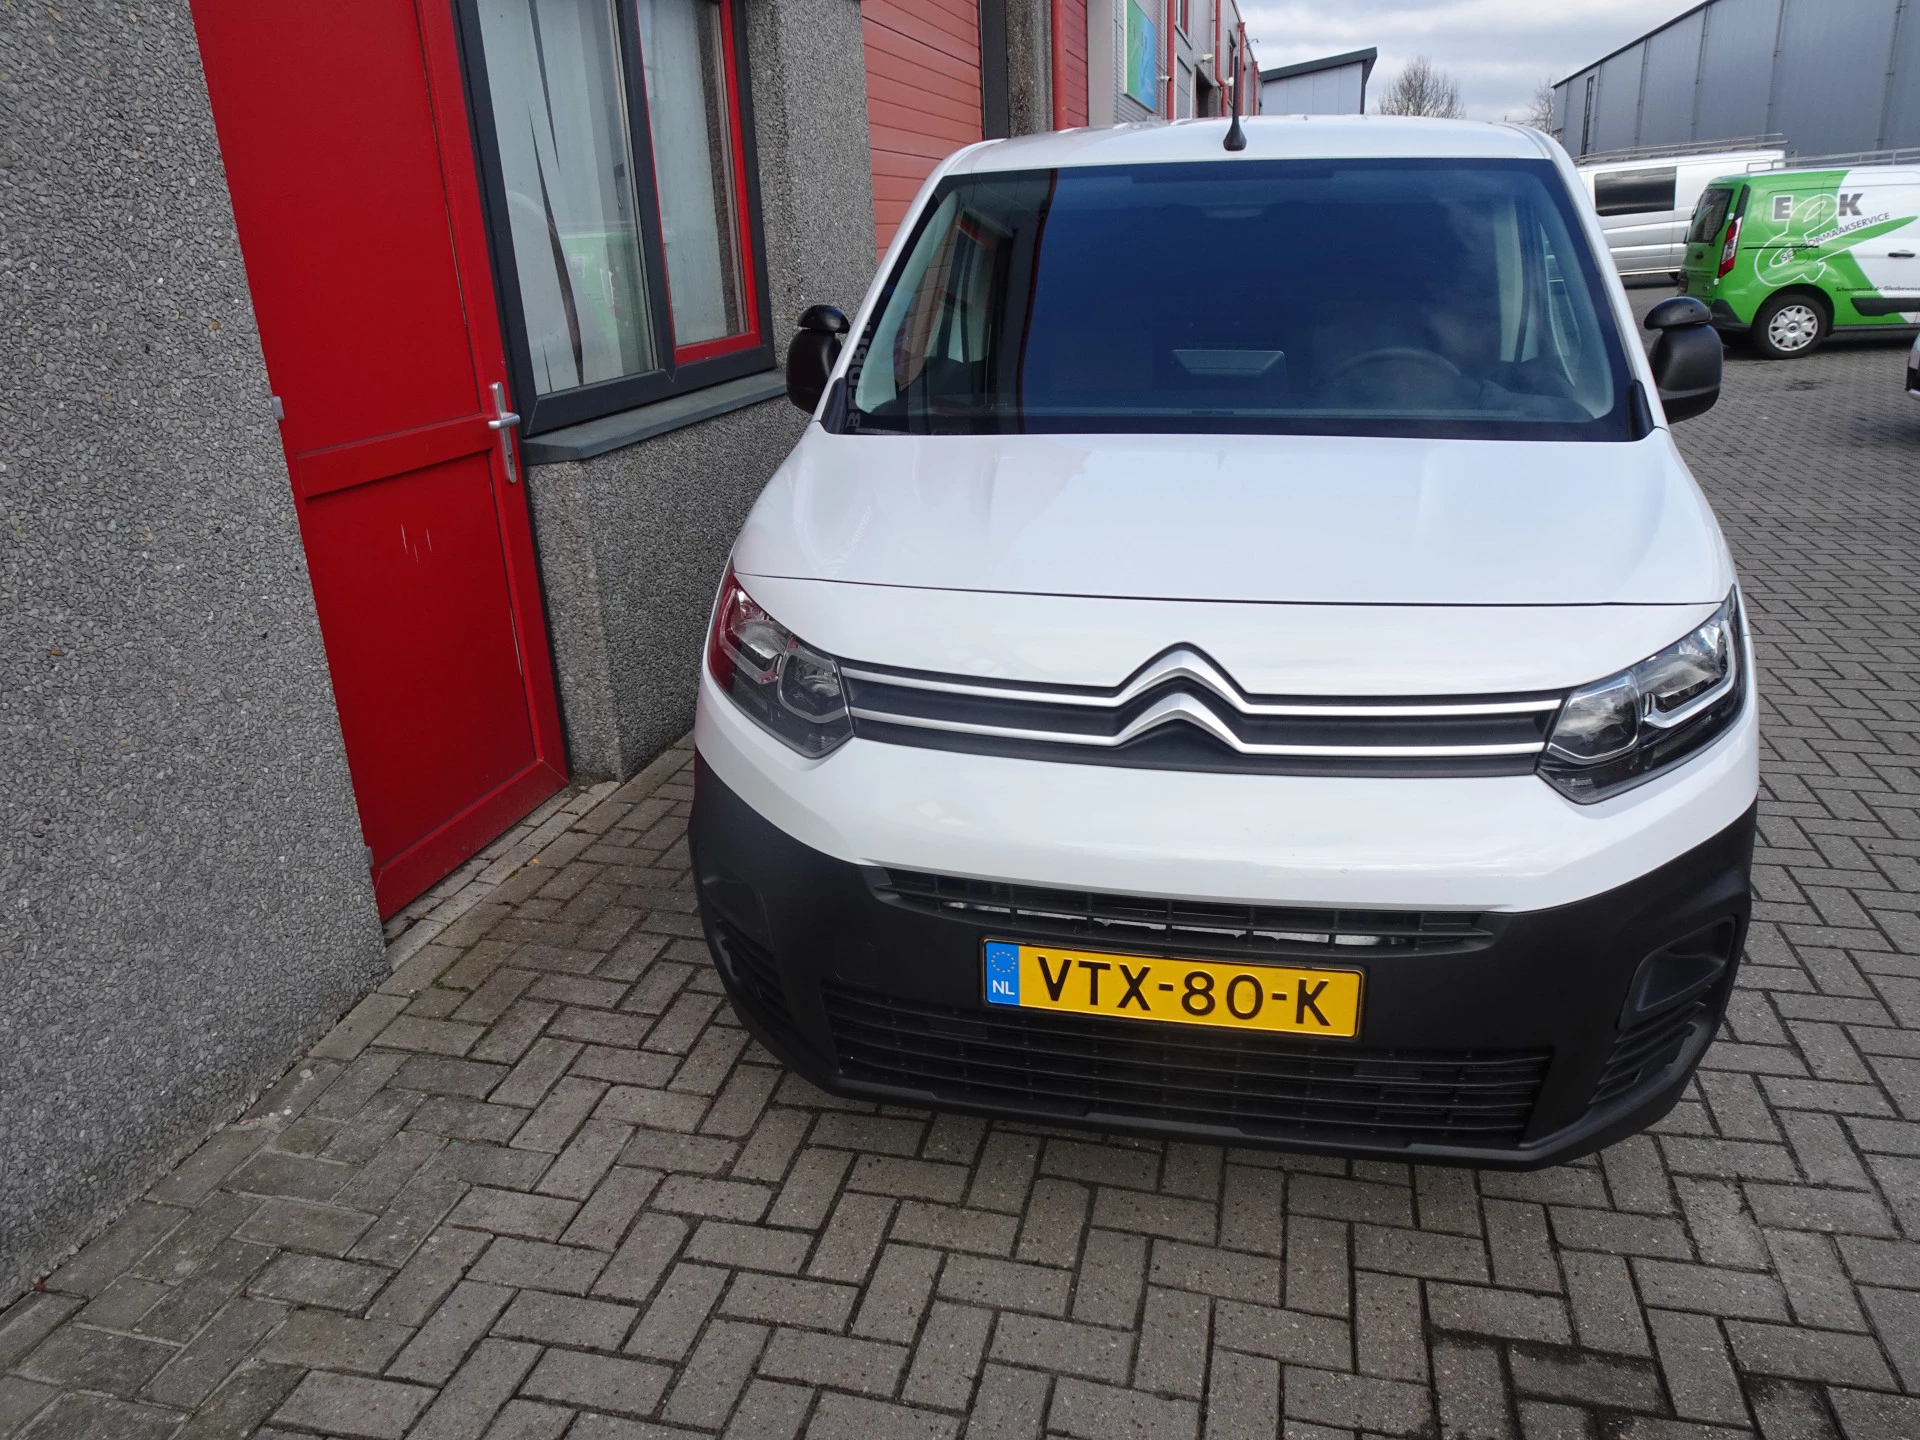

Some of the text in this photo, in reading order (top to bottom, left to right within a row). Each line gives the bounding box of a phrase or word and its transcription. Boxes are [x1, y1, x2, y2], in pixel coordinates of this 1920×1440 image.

[1780, 212, 1890, 262] SCHOONMAAKSERVICE
[992, 979, 1015, 996] NL
[1037, 955, 1331, 1027] VTX-80-K
